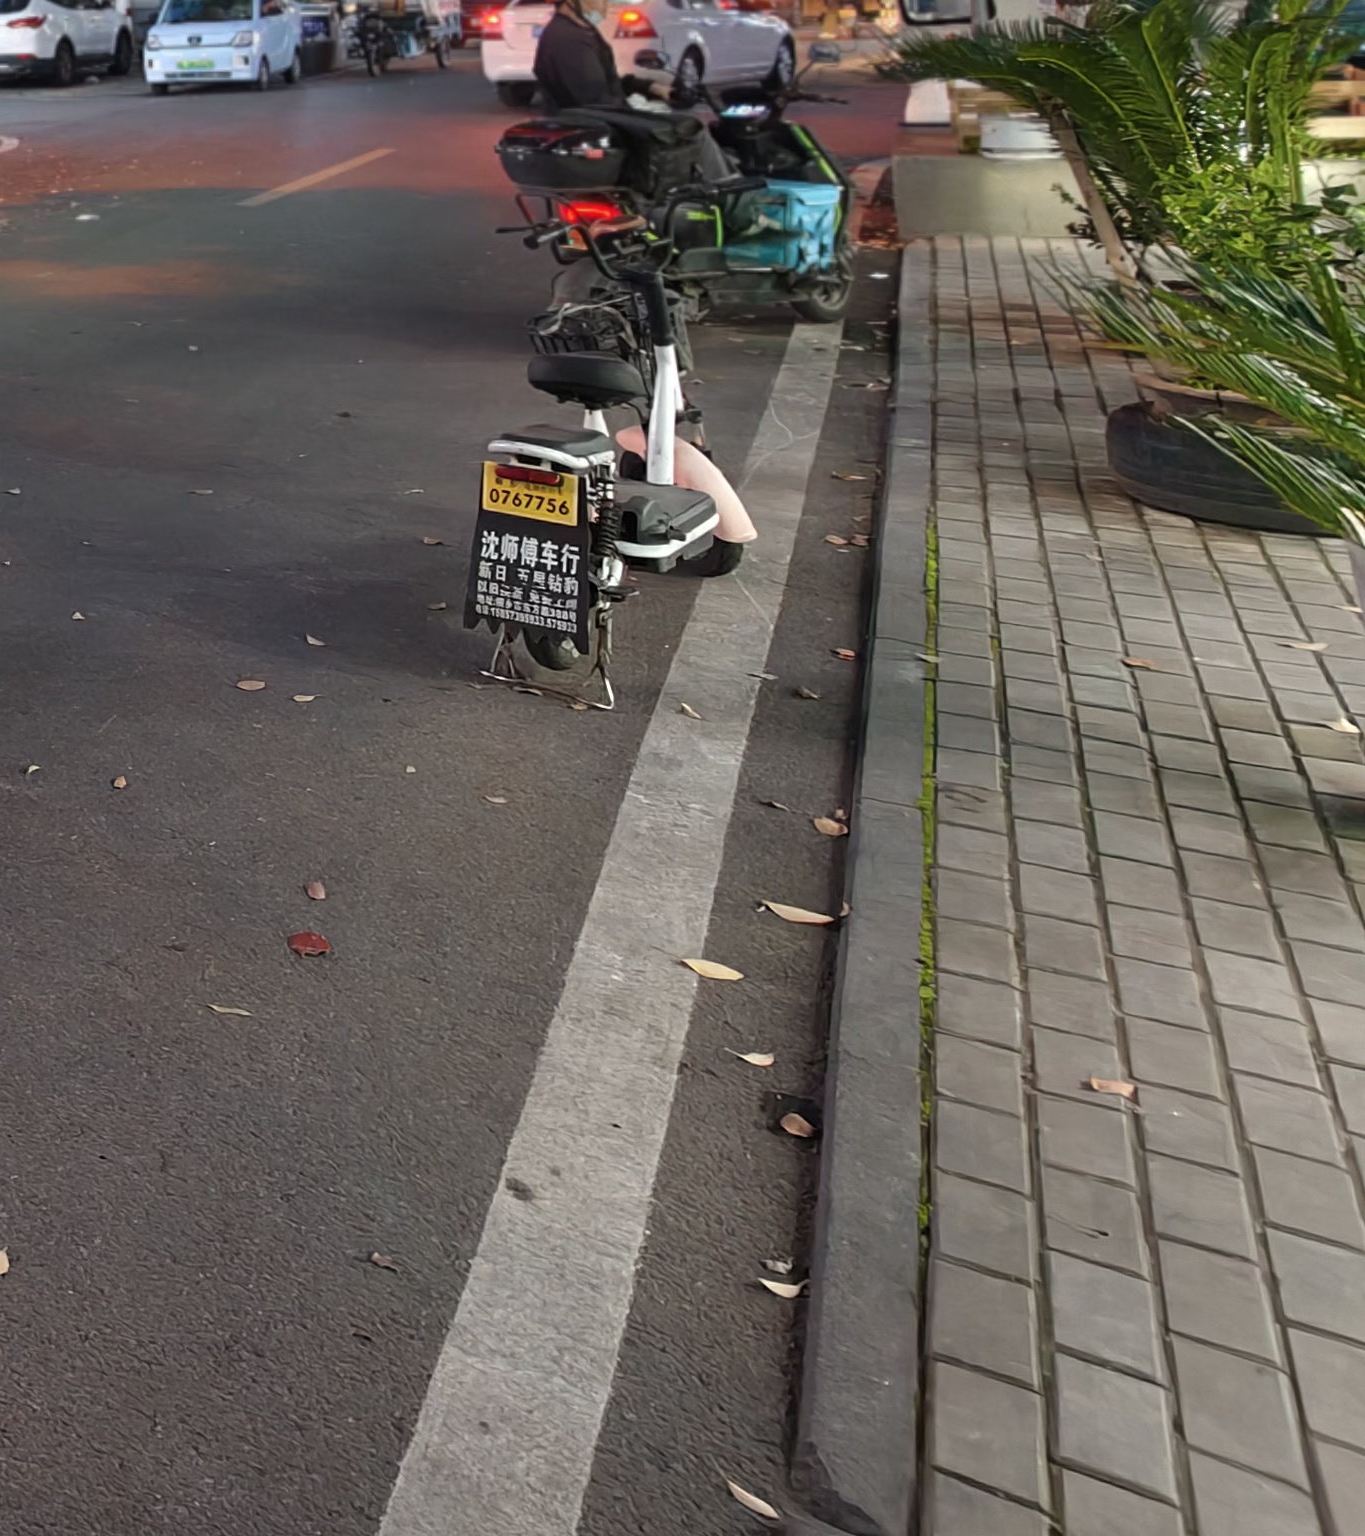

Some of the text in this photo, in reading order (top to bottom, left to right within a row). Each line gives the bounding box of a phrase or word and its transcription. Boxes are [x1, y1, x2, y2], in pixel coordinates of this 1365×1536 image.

[489, 488, 570, 515] 0767756
[480, 530, 580, 575] 沈师傅车行
